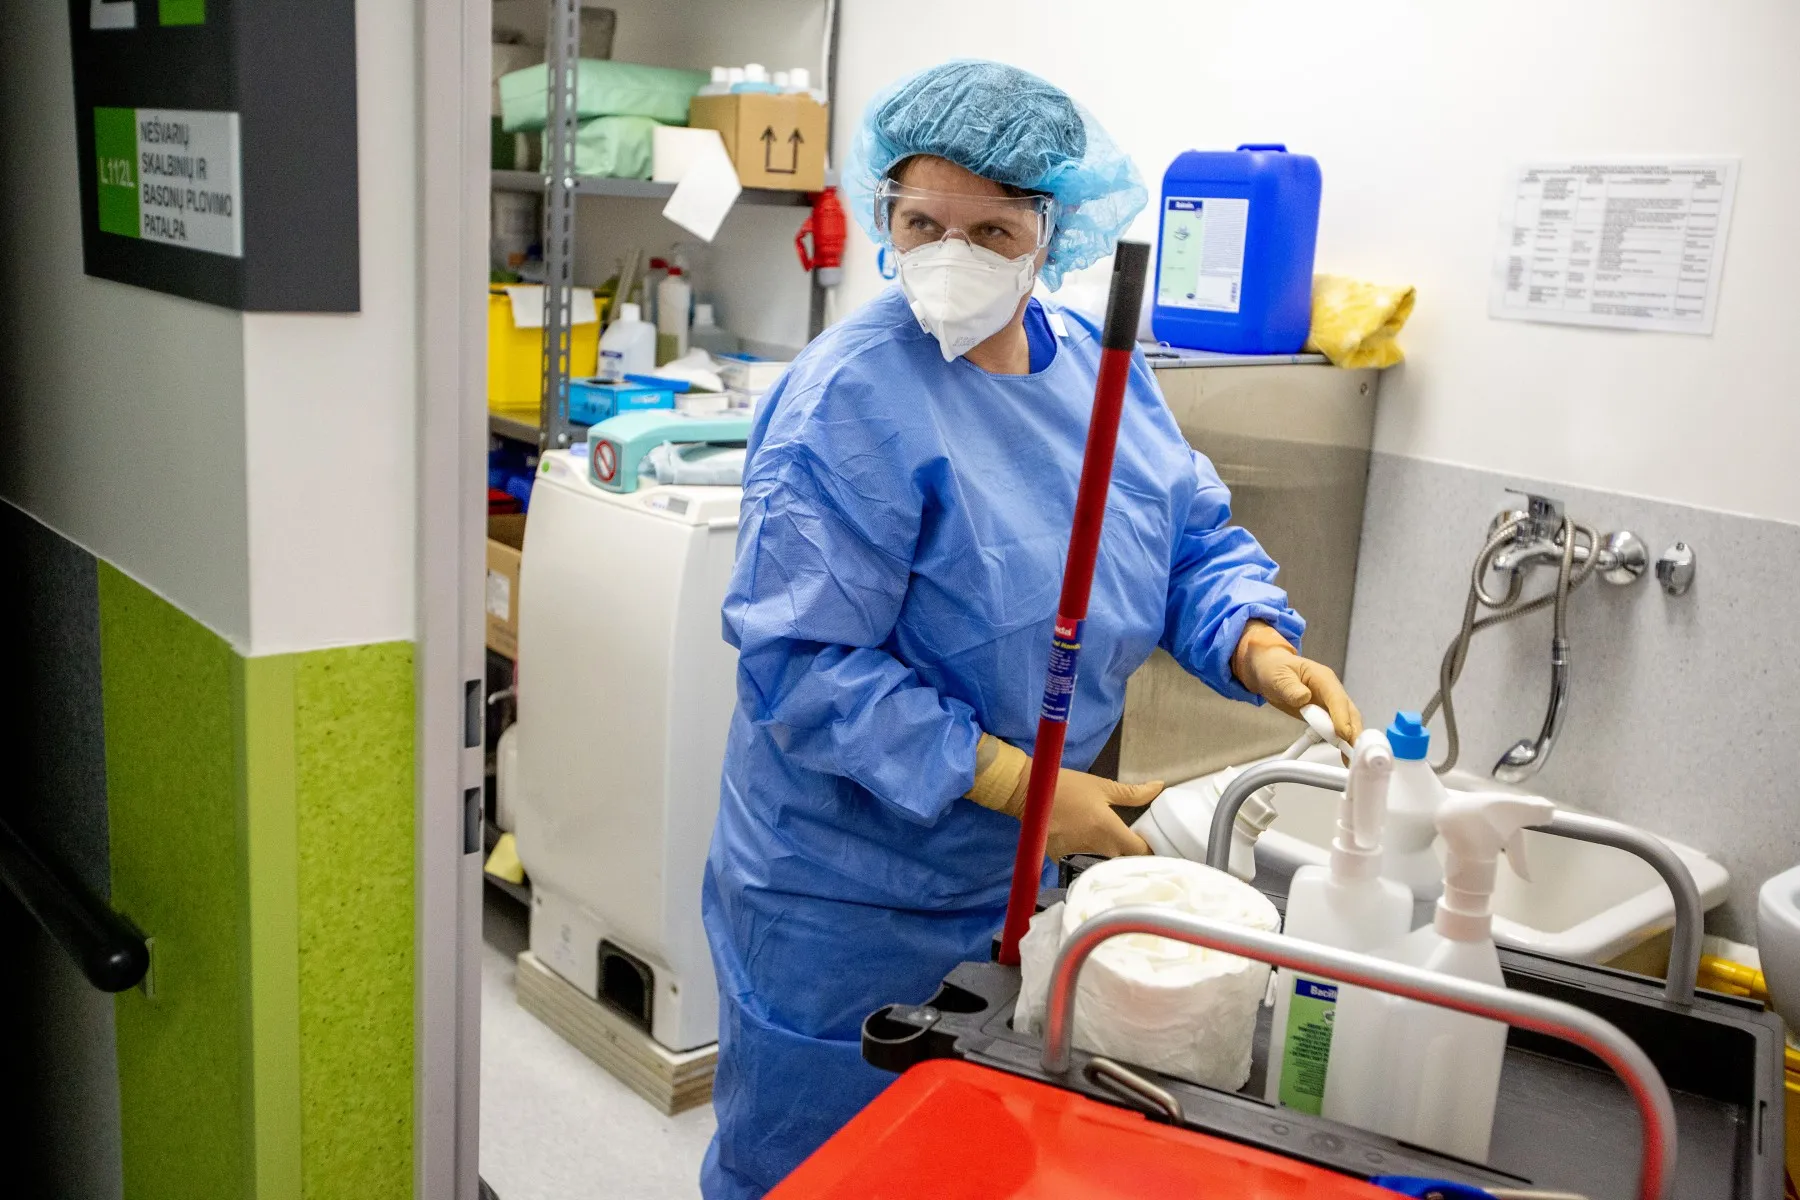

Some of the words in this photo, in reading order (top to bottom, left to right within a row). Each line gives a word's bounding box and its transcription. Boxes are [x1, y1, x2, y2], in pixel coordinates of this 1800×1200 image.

[141, 116, 189, 149] NEŠVARIŲ
[142, 152, 193, 184] SKALBINIŲ
[195, 157, 207, 180] IR
[143, 184, 184, 214] BASONŲ
[186, 189, 232, 218] PLOVIMO
[144, 213, 188, 241] PATALPA
